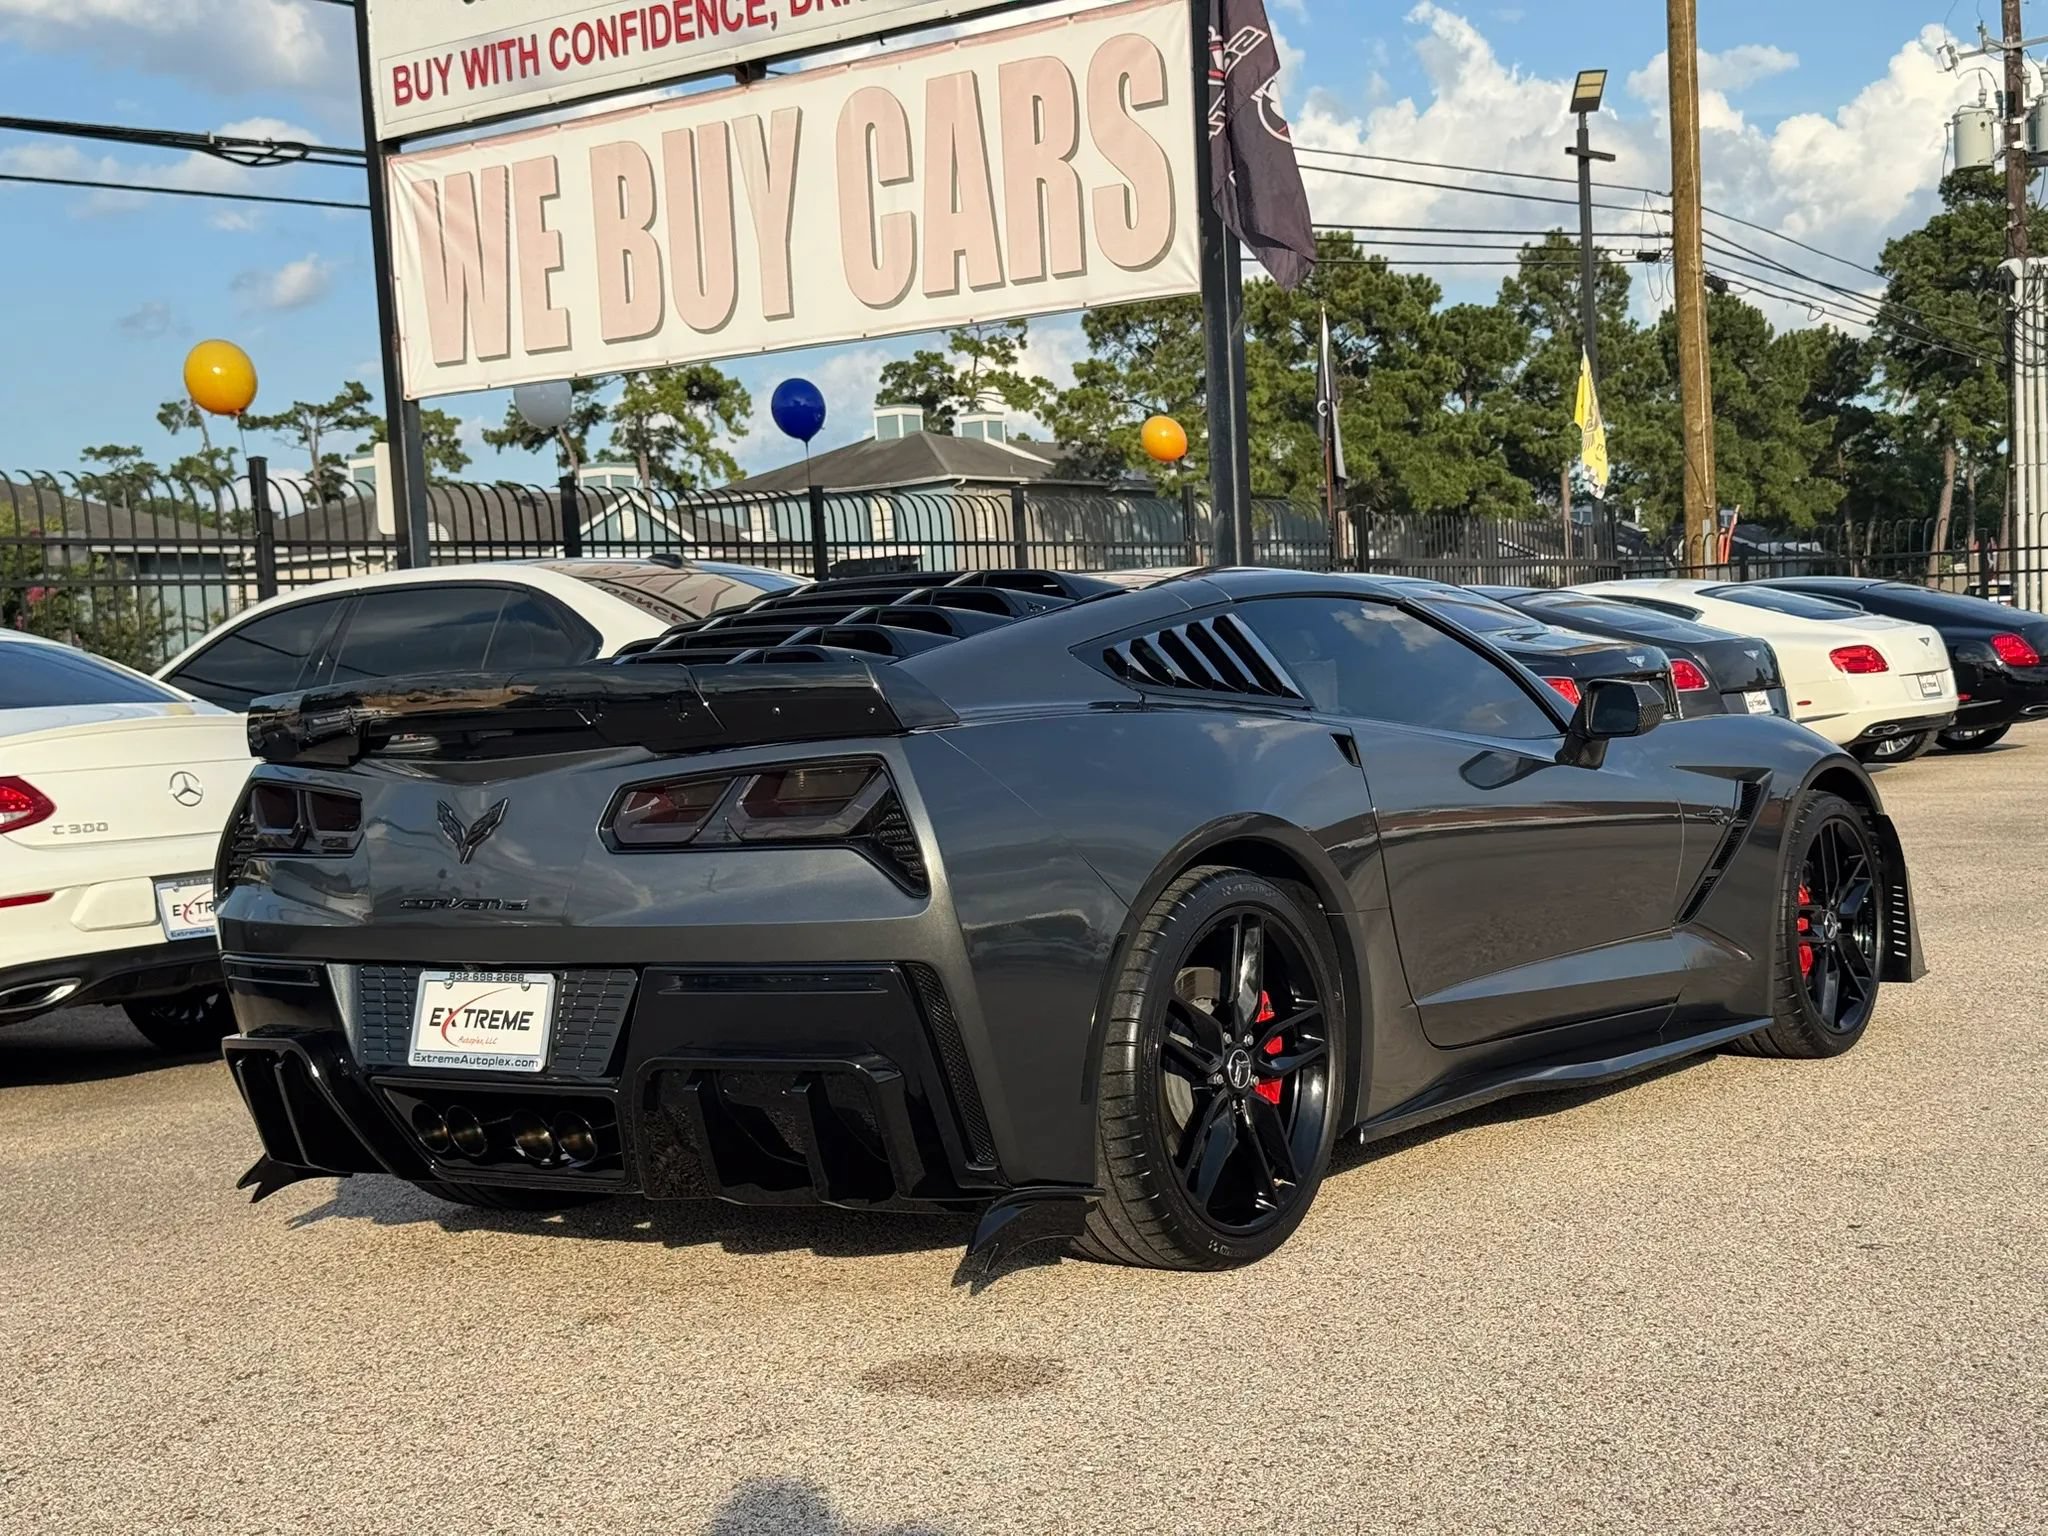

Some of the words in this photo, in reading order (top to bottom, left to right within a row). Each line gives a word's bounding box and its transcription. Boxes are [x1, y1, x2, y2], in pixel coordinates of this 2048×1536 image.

[392, 54, 453, 106] BUY
[461, 34, 541, 91] WITH
[549, 0, 778, 71] CONFIDENCE,
[411, 154, 573, 368] WE
[589, 105, 803, 344] BUY
[835, 32, 1178, 310] CARS
[69, 821, 109, 835] 300
[172, 901, 215, 917] EXTR
[428, 1007, 535, 1032] EXTREME
[412, 1052, 539, 1069] ExtremeAutoplex.com
